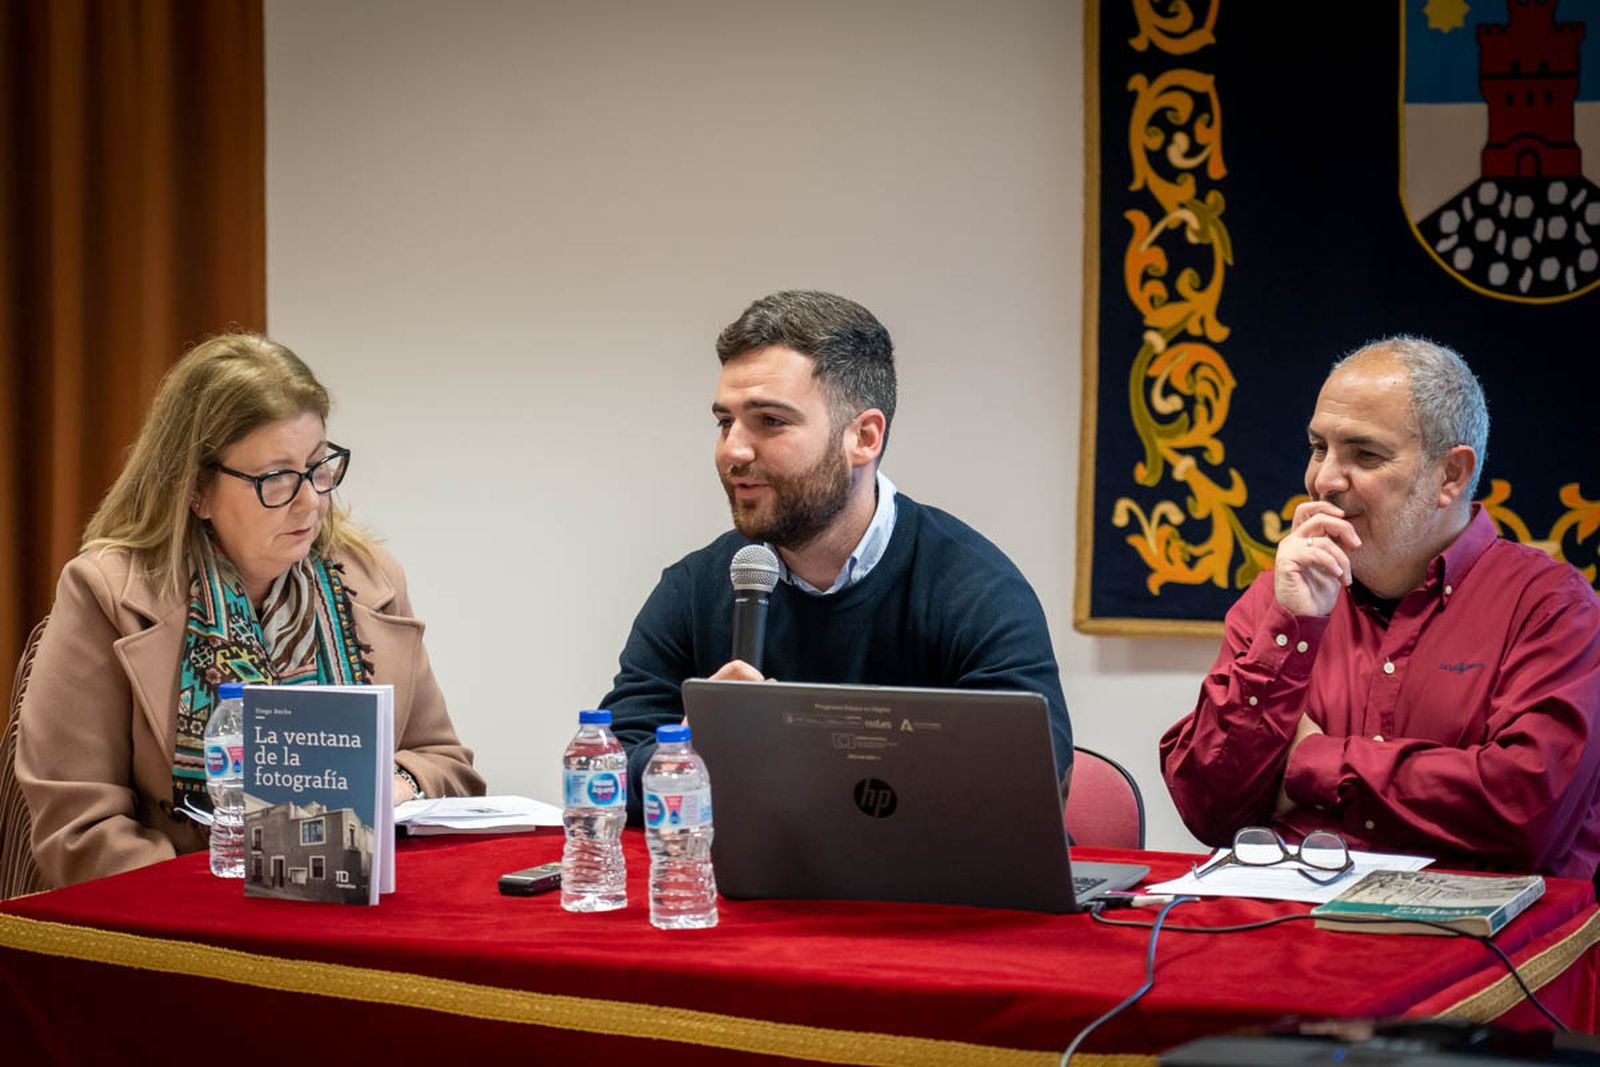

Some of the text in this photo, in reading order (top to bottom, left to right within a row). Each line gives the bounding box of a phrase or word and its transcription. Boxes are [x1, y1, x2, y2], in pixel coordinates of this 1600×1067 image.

[255, 726, 362, 748] La ventana
[254, 745, 301, 766] de la
[255, 766, 349, 792] fotografía
[860, 779, 891, 817] hp
